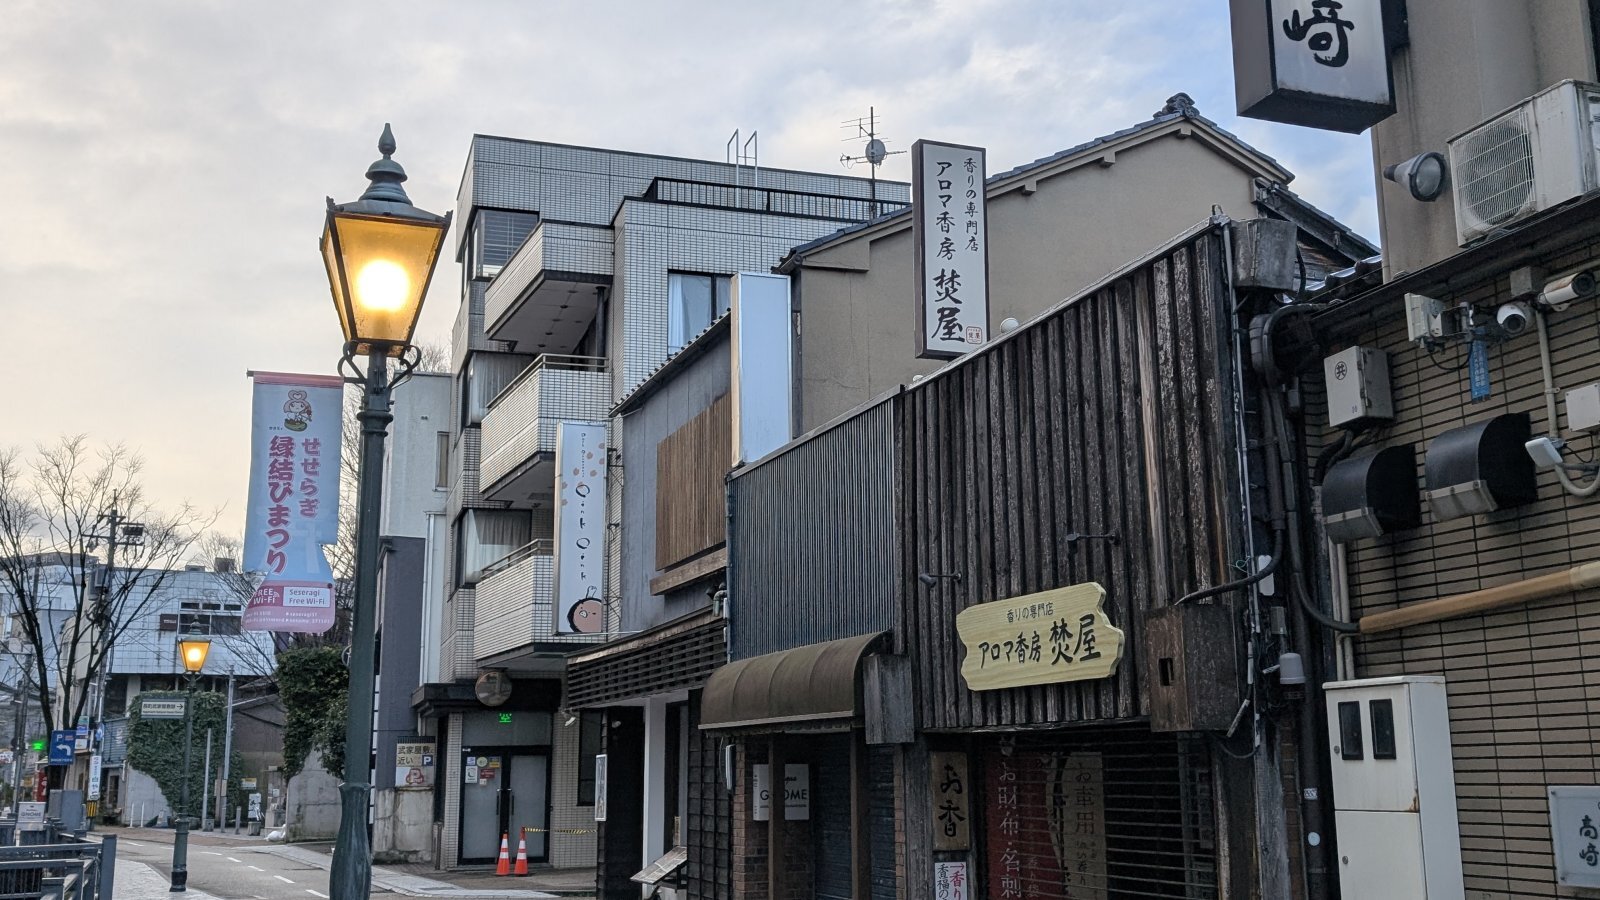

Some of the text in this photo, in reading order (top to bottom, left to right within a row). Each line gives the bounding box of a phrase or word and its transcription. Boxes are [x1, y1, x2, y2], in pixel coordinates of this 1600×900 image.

[963, 157, 978, 252] 香りの専門店
[931, 161, 965, 343] アロマ香房 焚屋
[266, 435, 294, 573] 縁結びまつり
[299, 437, 321, 518] せせらぎ
[289, 589, 320, 597] Seseragi
[1006, 602, 1054, 623] 香りの専門店
[978, 613, 1101, 669] アロマ香房 焚屋
[56, 734, 63, 742] P
[423, 756, 432, 765] P
[760, 789, 808, 801] GOME
[938, 764, 966, 838] お香
